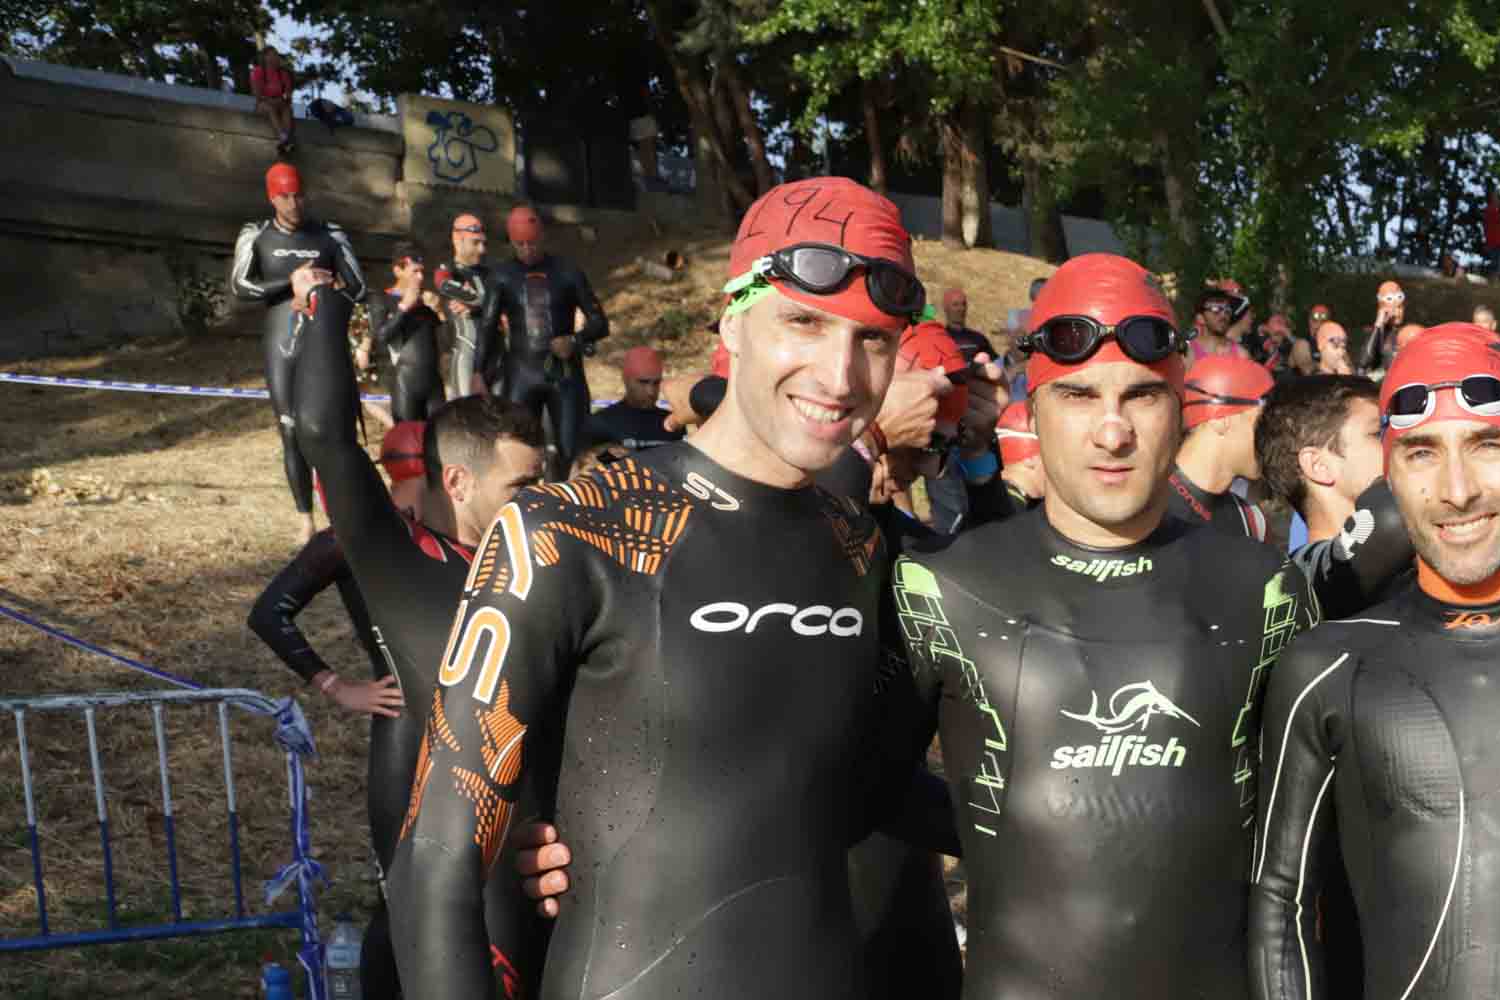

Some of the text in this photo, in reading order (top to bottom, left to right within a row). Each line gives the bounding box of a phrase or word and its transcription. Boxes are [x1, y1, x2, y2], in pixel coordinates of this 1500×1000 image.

[1051, 554, 1153, 582] sailfish
[690, 602, 863, 636] orca
[1051, 735, 1187, 777] sailfish
